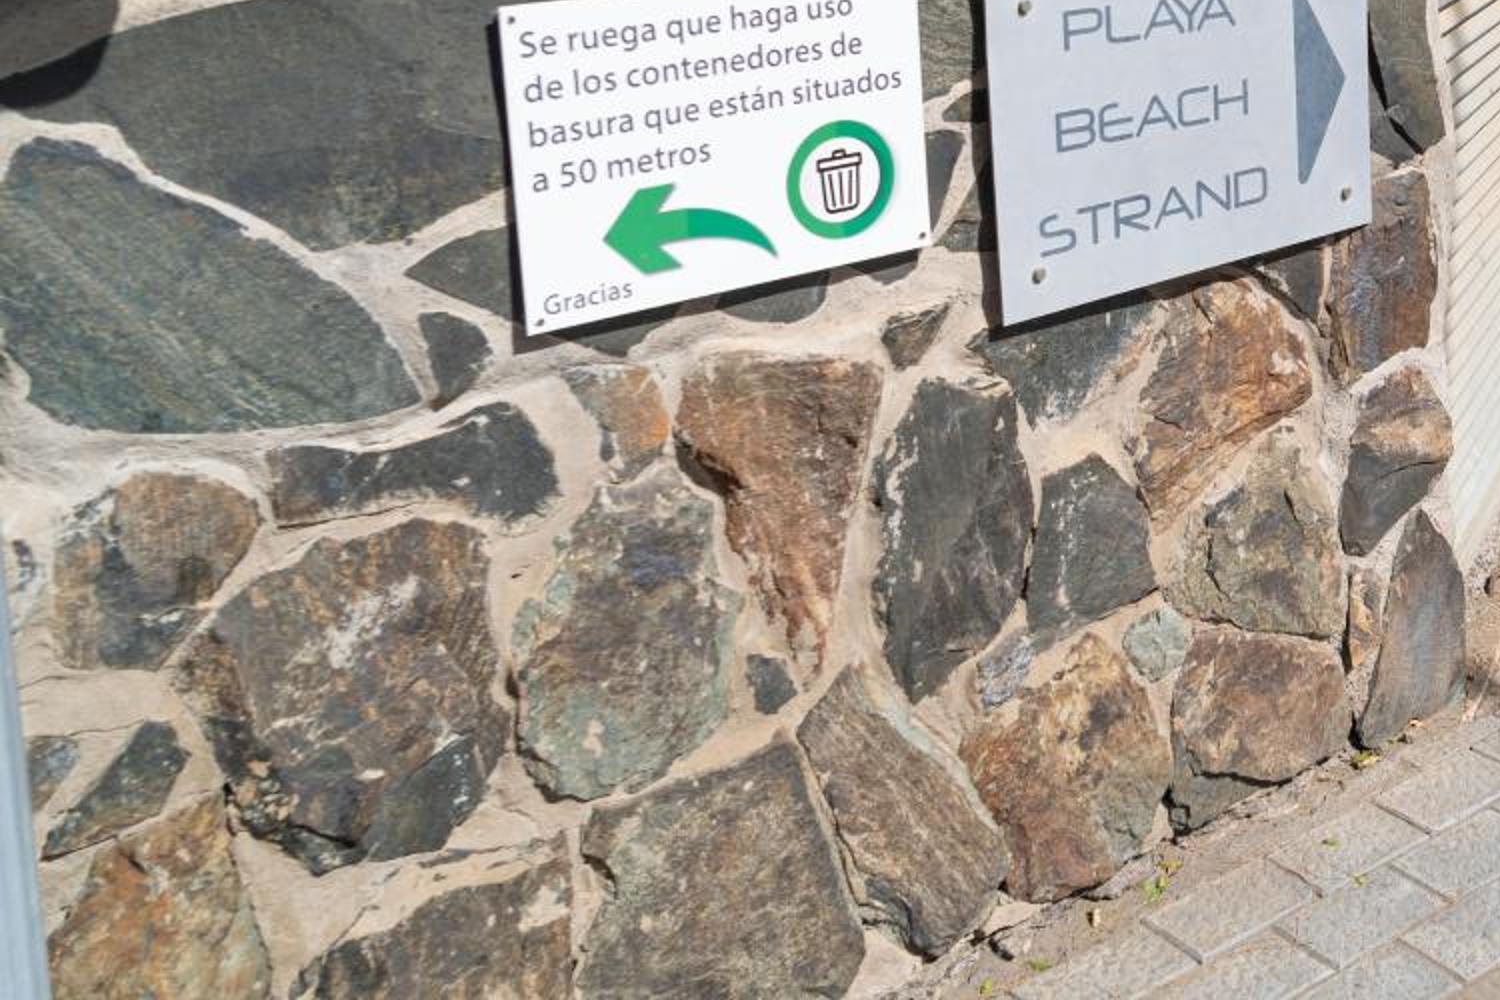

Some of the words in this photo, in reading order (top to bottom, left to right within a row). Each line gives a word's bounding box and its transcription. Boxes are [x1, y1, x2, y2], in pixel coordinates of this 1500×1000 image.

[519, 30, 557, 58] Se
[568, 22, 656, 52] ruega
[666, 11, 721, 43] que
[730, 4, 798, 33] haga
[524, 75, 563, 102] de
[573, 68, 617, 96] los
[626, 42, 823, 87] contenedores
[831, 32, 863, 56] de
[529, 110, 635, 148] basura
[645, 104, 700, 135] que
[709, 86, 784, 118] están
[793, 67, 902, 105] situados
[1055, 78, 1249, 153] BEACH
[532, 172, 549, 193] a
[560, 158, 597, 188] 50
[607, 141, 712, 179] metros
[1039, 166, 1268, 258] STRAND
[543, 281, 633, 315] Gracias
